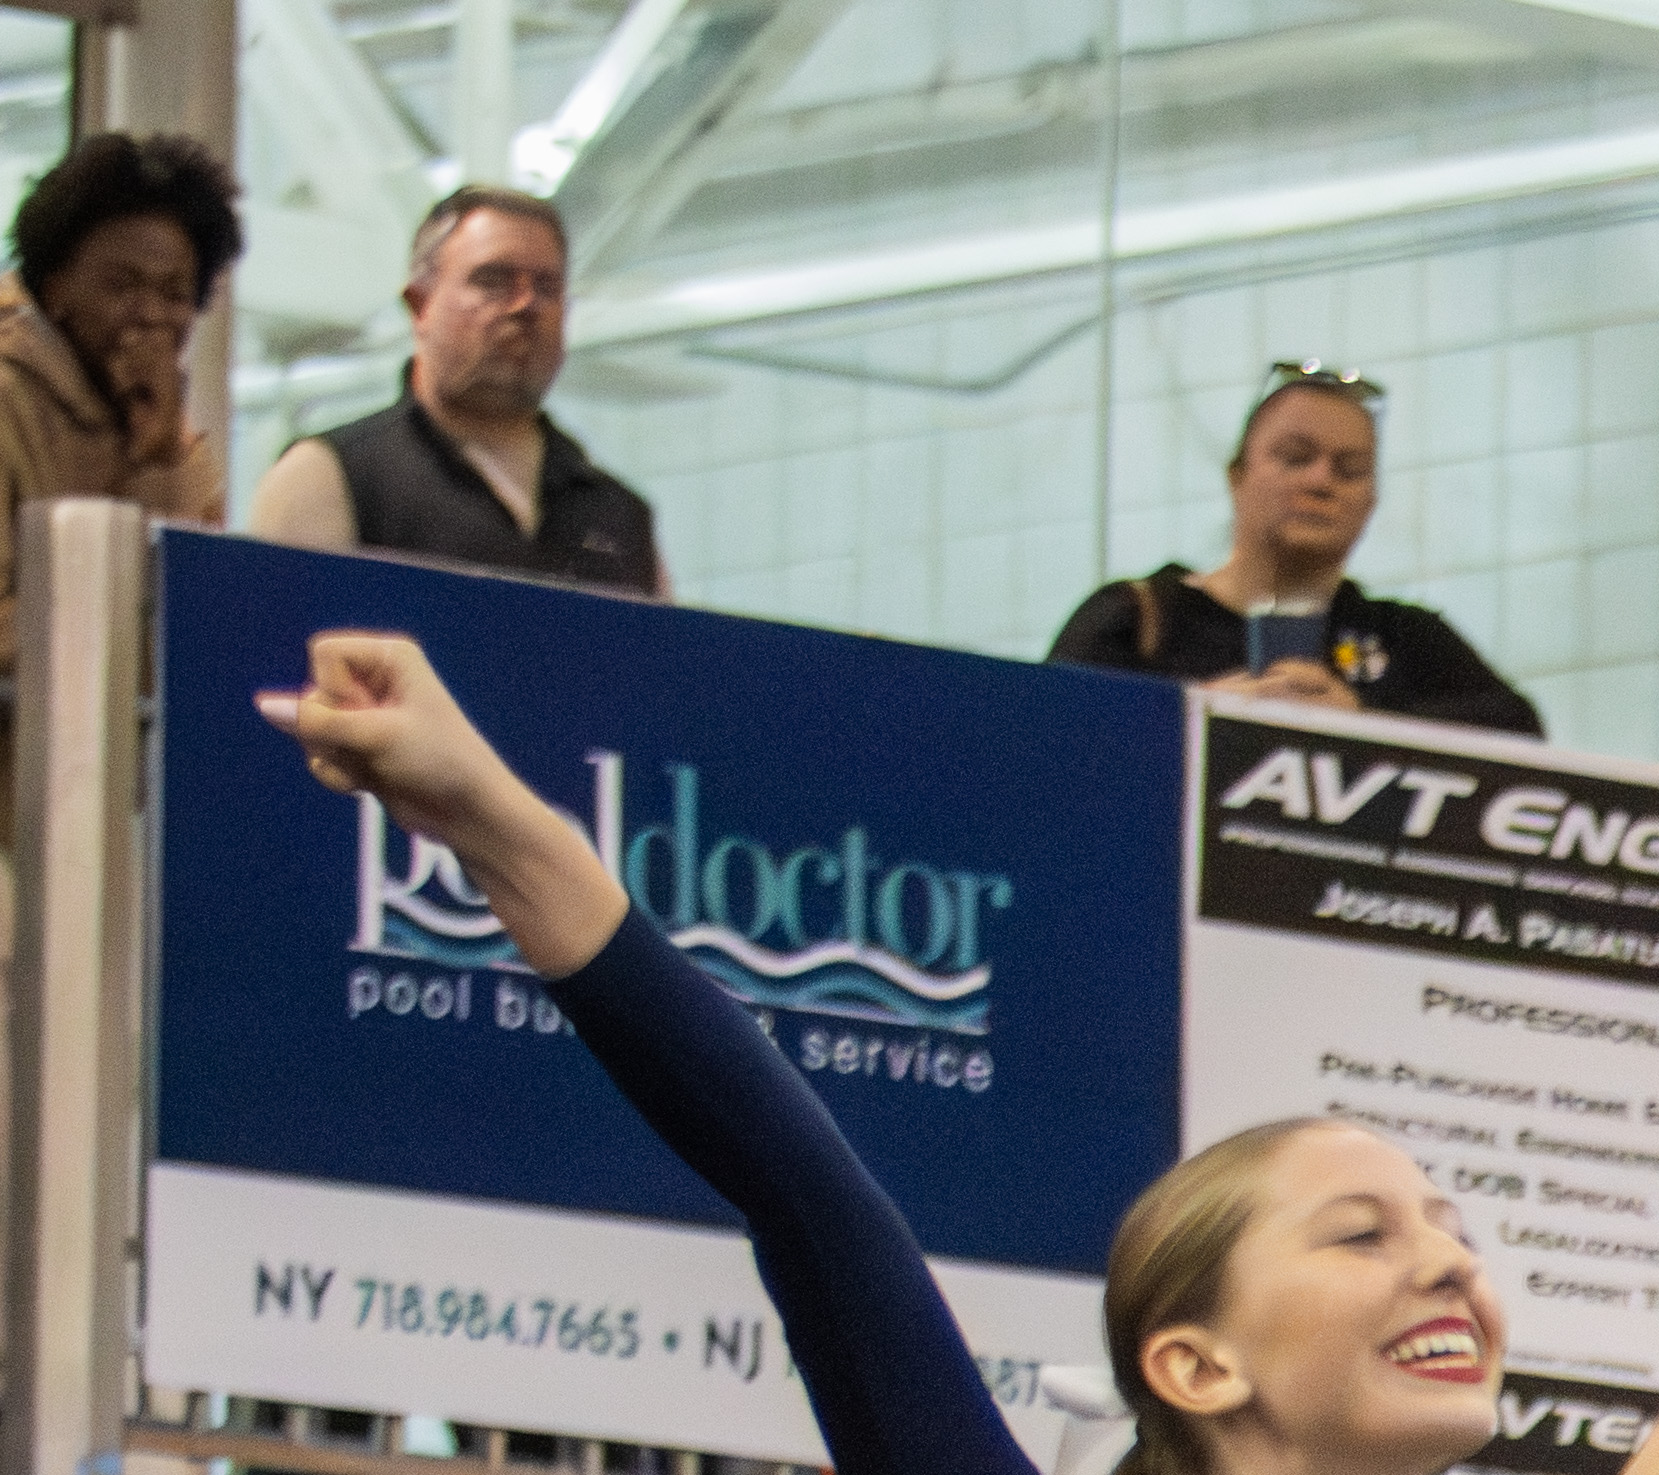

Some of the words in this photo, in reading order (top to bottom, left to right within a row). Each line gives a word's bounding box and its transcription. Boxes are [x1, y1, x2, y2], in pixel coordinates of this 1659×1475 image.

[1222, 746, 1480, 838] AVT
[349, 967, 472, 1020] pool
[803, 1030, 994, 1092] service
[254, 1261, 335, 1320] NY
[353, 1279, 640, 1358] 718.984.7665
[703, 1314, 766, 1383] NJ
